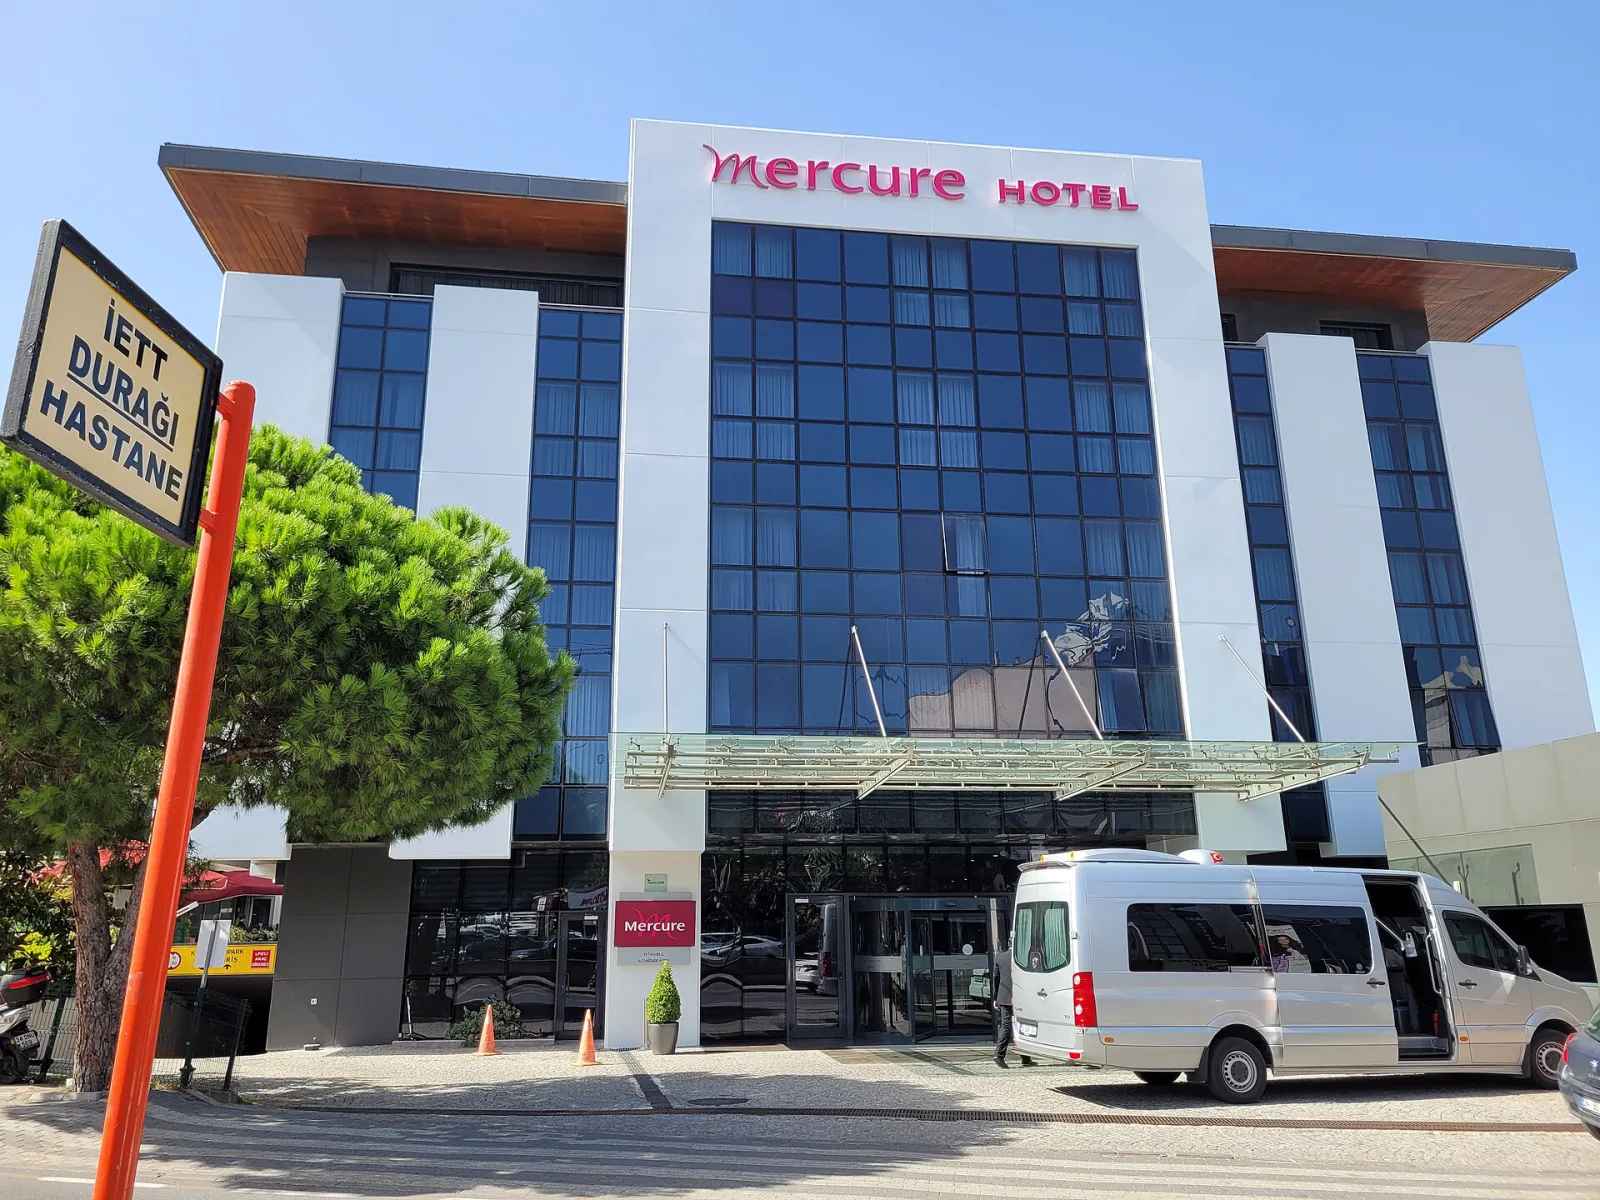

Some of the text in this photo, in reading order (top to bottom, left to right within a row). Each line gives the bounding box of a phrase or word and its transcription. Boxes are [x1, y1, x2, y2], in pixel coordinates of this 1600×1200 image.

[998, 178, 1139, 211] HOTEL
[103, 298, 168, 381] İETT
[68, 335, 179, 447] DURAĞI
[40, 380, 183, 502] HASTANE
[624, 921, 686, 932] Mercure
